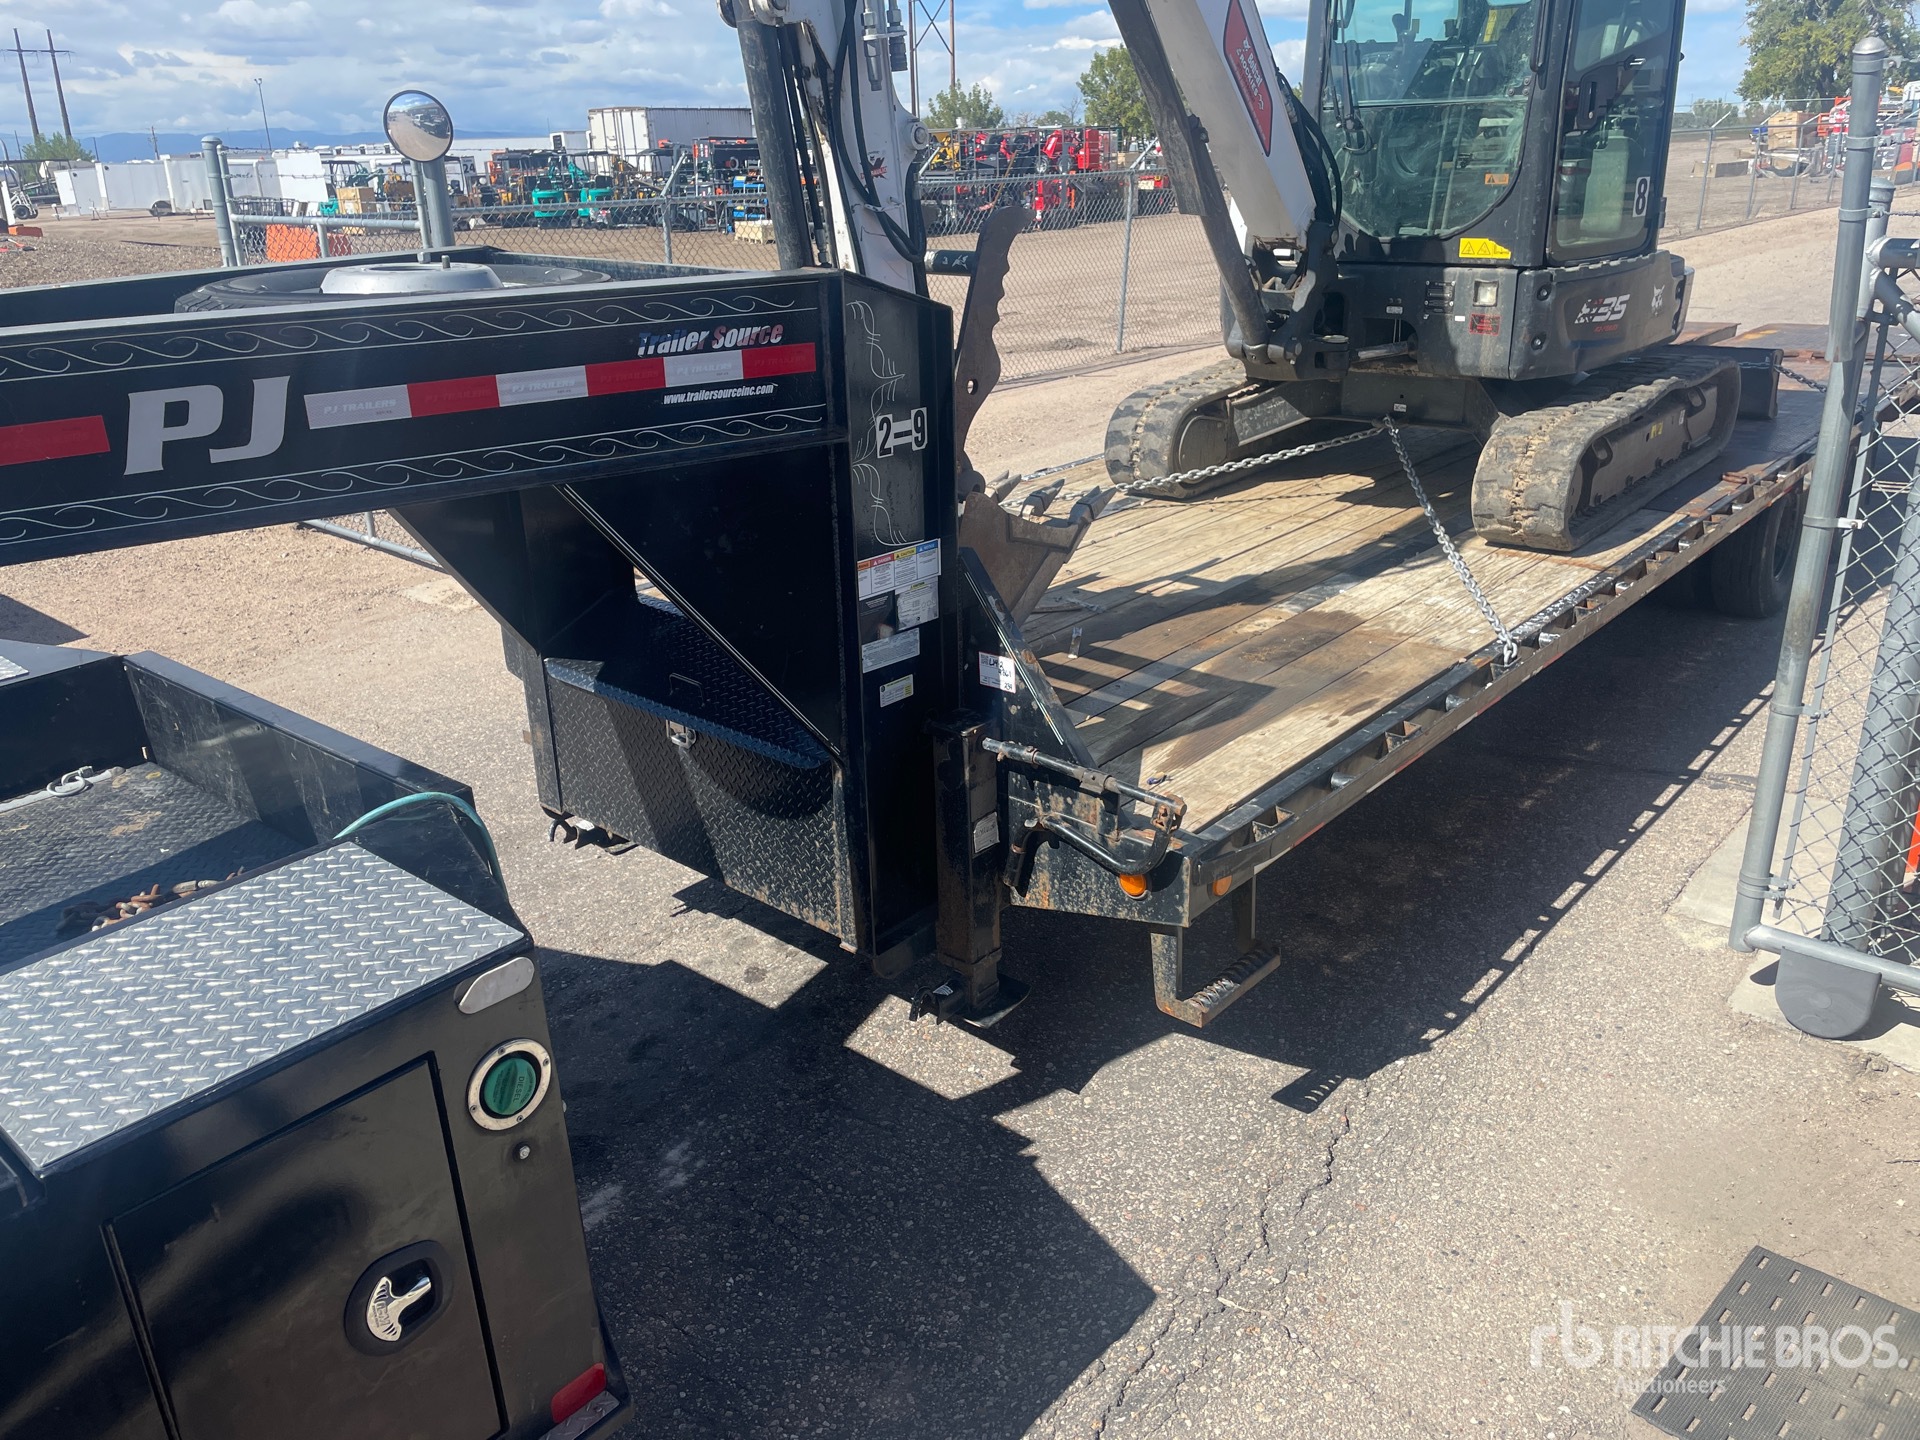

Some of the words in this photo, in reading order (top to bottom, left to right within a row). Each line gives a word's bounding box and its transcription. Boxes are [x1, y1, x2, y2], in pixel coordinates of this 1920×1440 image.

[1240, 54, 1258, 96] ROCKIES
[1248, 53, 1263, 87] Bobcat
[463, 163, 476, 173] 24
[1635, 178, 1648, 215] 8
[637, 329, 710, 356] Trailer
[712, 324, 784, 349] Source
[677, 366, 689, 375] PJ
[692, 362, 732, 372] TRAILERS
[512, 383, 526, 393] PJ
[529, 378, 576, 391] TRAILERS
[664, 385, 774, 404] www.trailersourceinc.com
[323, 405, 338, 415] PJ
[342, 399, 397, 412] TRAILERS
[124, 375, 291, 476] PJ
[513, 1076, 525, 1102] DIESEL
